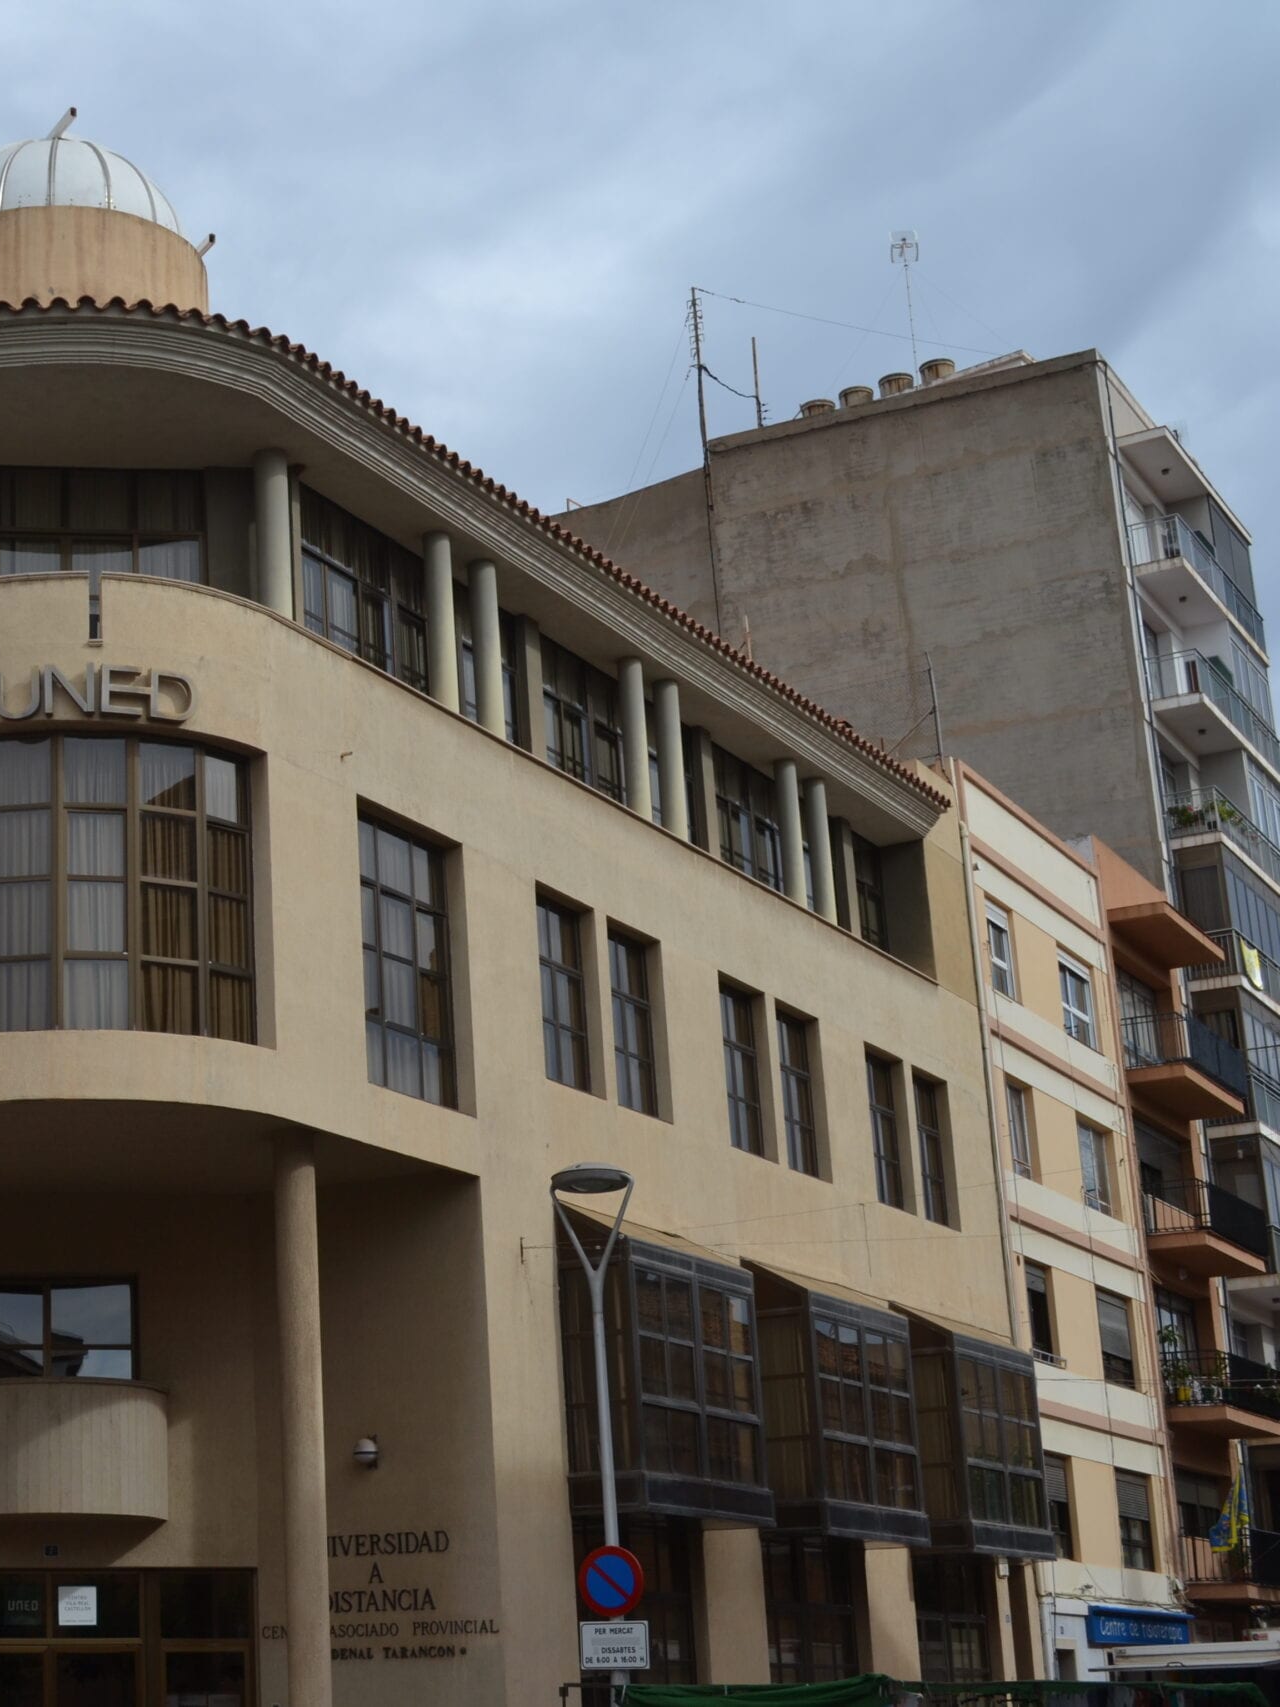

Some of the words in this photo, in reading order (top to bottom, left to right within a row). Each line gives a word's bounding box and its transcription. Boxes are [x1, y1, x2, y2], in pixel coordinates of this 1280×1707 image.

[327, 1530, 449, 1557] IVERSIDAD
[368, 1562, 384, 1584] A
[8, 1600, 39, 1611] UNED
[262, 1625, 288, 1640] CEN
[330, 1622, 399, 1638] ASOCIADO
[413, 1619, 500, 1635] PROVINCIAL
[1100, 1616, 1127, 1636] Centre
[331, 1647, 374, 1660] DENAL
[382, 1645, 455, 1659] TARANCON
